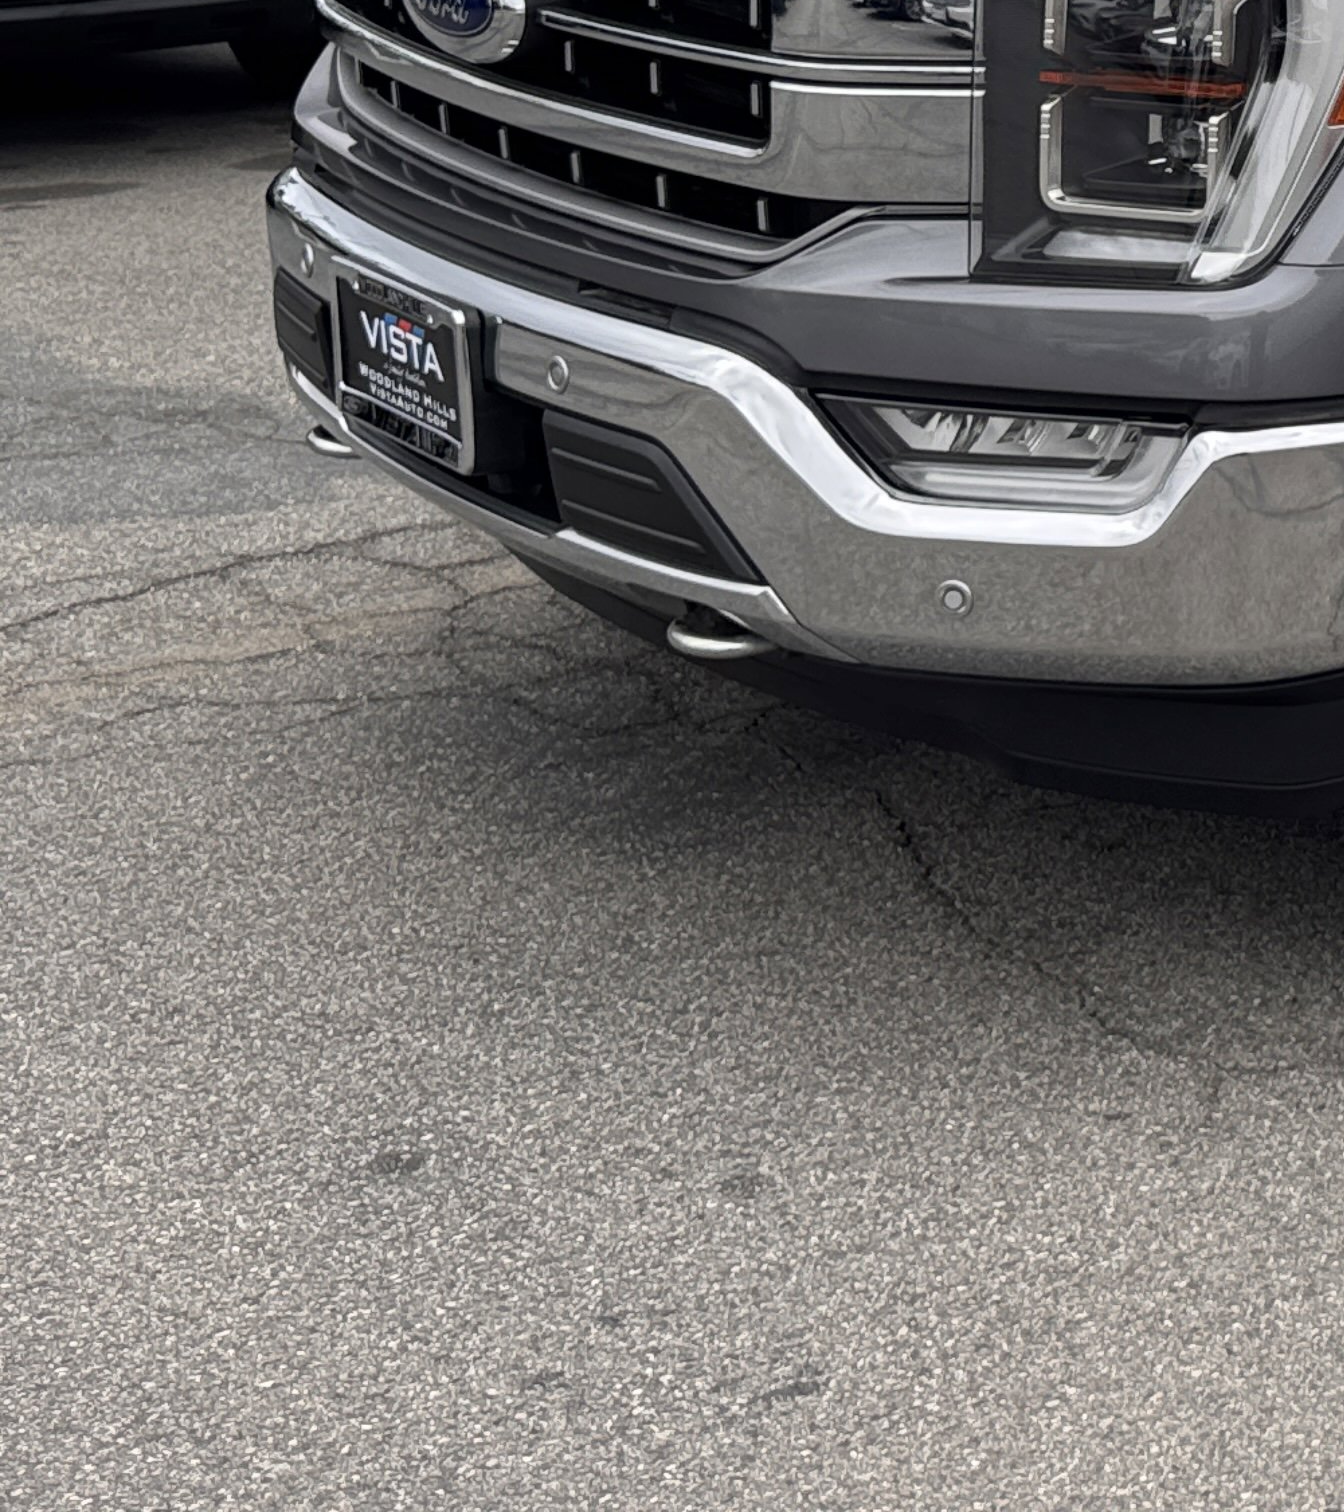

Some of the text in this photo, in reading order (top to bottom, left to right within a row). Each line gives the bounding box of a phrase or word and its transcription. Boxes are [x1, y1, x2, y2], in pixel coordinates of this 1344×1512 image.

[360, 309, 445, 383] VISTA
[360, 362, 420, 402] WOODLAND
[422, 392, 457, 423] HILLS
